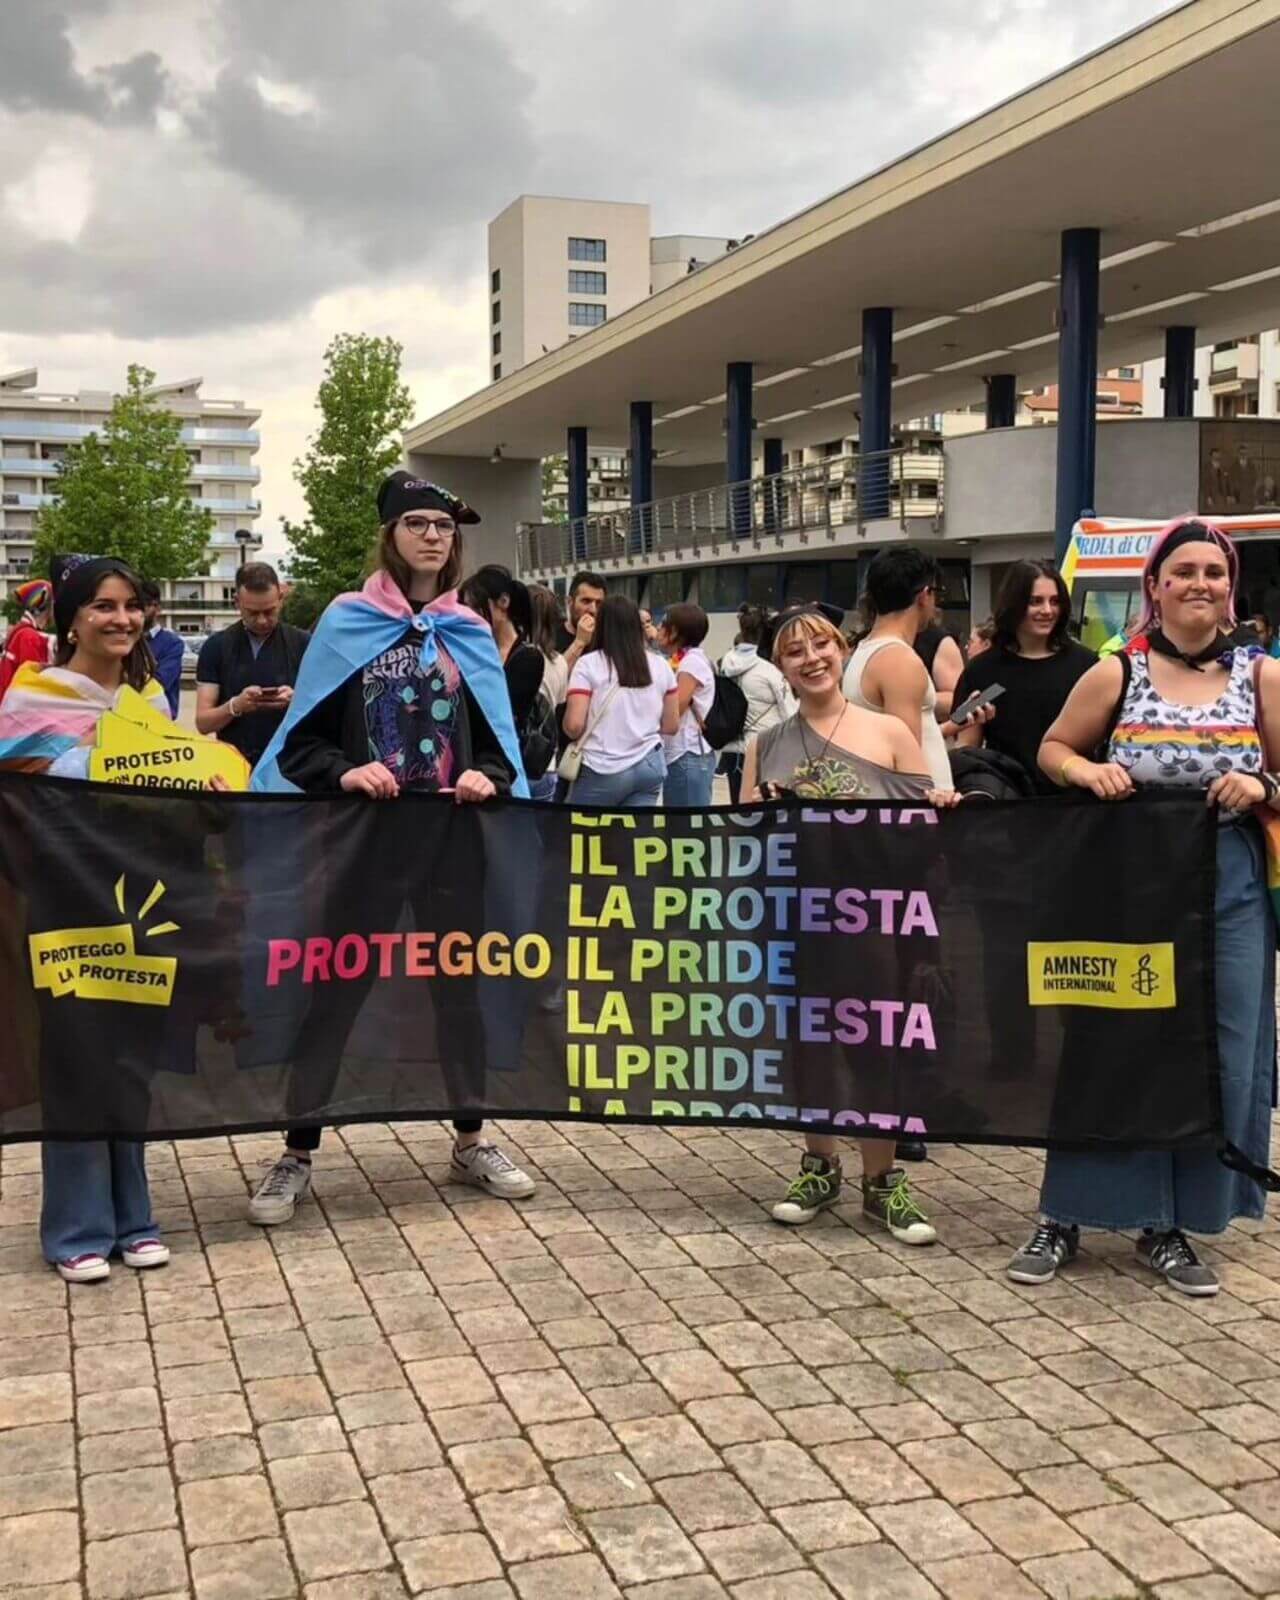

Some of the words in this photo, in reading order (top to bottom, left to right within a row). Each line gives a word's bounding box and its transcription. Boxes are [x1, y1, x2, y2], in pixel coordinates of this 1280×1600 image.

[1078, 536, 1114, 555] RDIA
[1118, 535, 1133, 554] di
[104, 747, 194, 771] PROTESTO
[571, 834, 618, 876] IL
[633, 833, 797, 877] PRIDE
[569, 884, 636, 928] LA
[653, 887, 940, 936] PROTESTA
[39, 943, 126, 965] PROTEGGO
[266, 931, 551, 986] PROTEGGO
[567, 936, 615, 981] IL
[631, 939, 796, 986] PRIDE
[58, 968, 75, 983] LA
[79, 964, 168, 987] PROTESTA
[1043, 956, 1117, 977] AMNESTY
[1043, 978, 1117, 993] INTERNATIONAL
[567, 989, 635, 1034] LA
[651, 993, 937, 1050] PROTESTA
